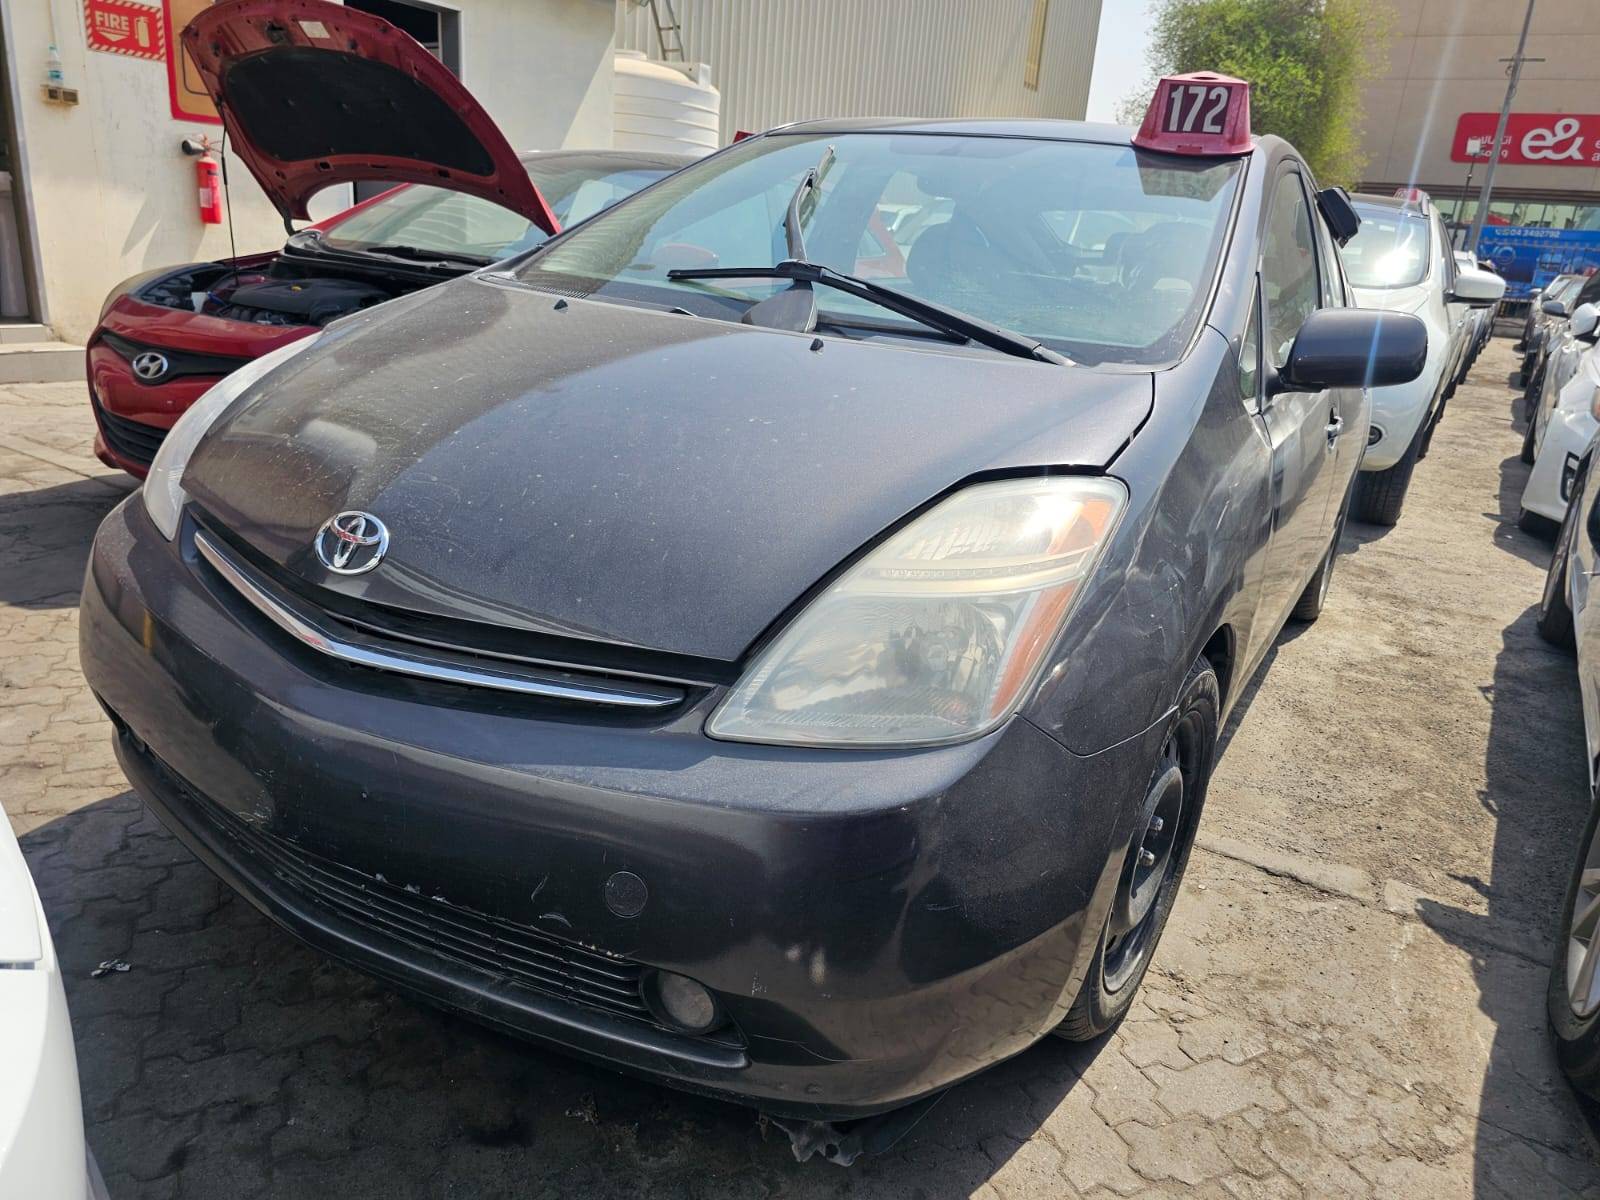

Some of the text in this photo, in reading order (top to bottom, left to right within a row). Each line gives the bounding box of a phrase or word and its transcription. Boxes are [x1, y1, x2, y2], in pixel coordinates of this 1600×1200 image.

[95, 10, 130, 31] FIRE
[1168, 85, 1228, 133] 172
[1520, 117, 1584, 160] e&
